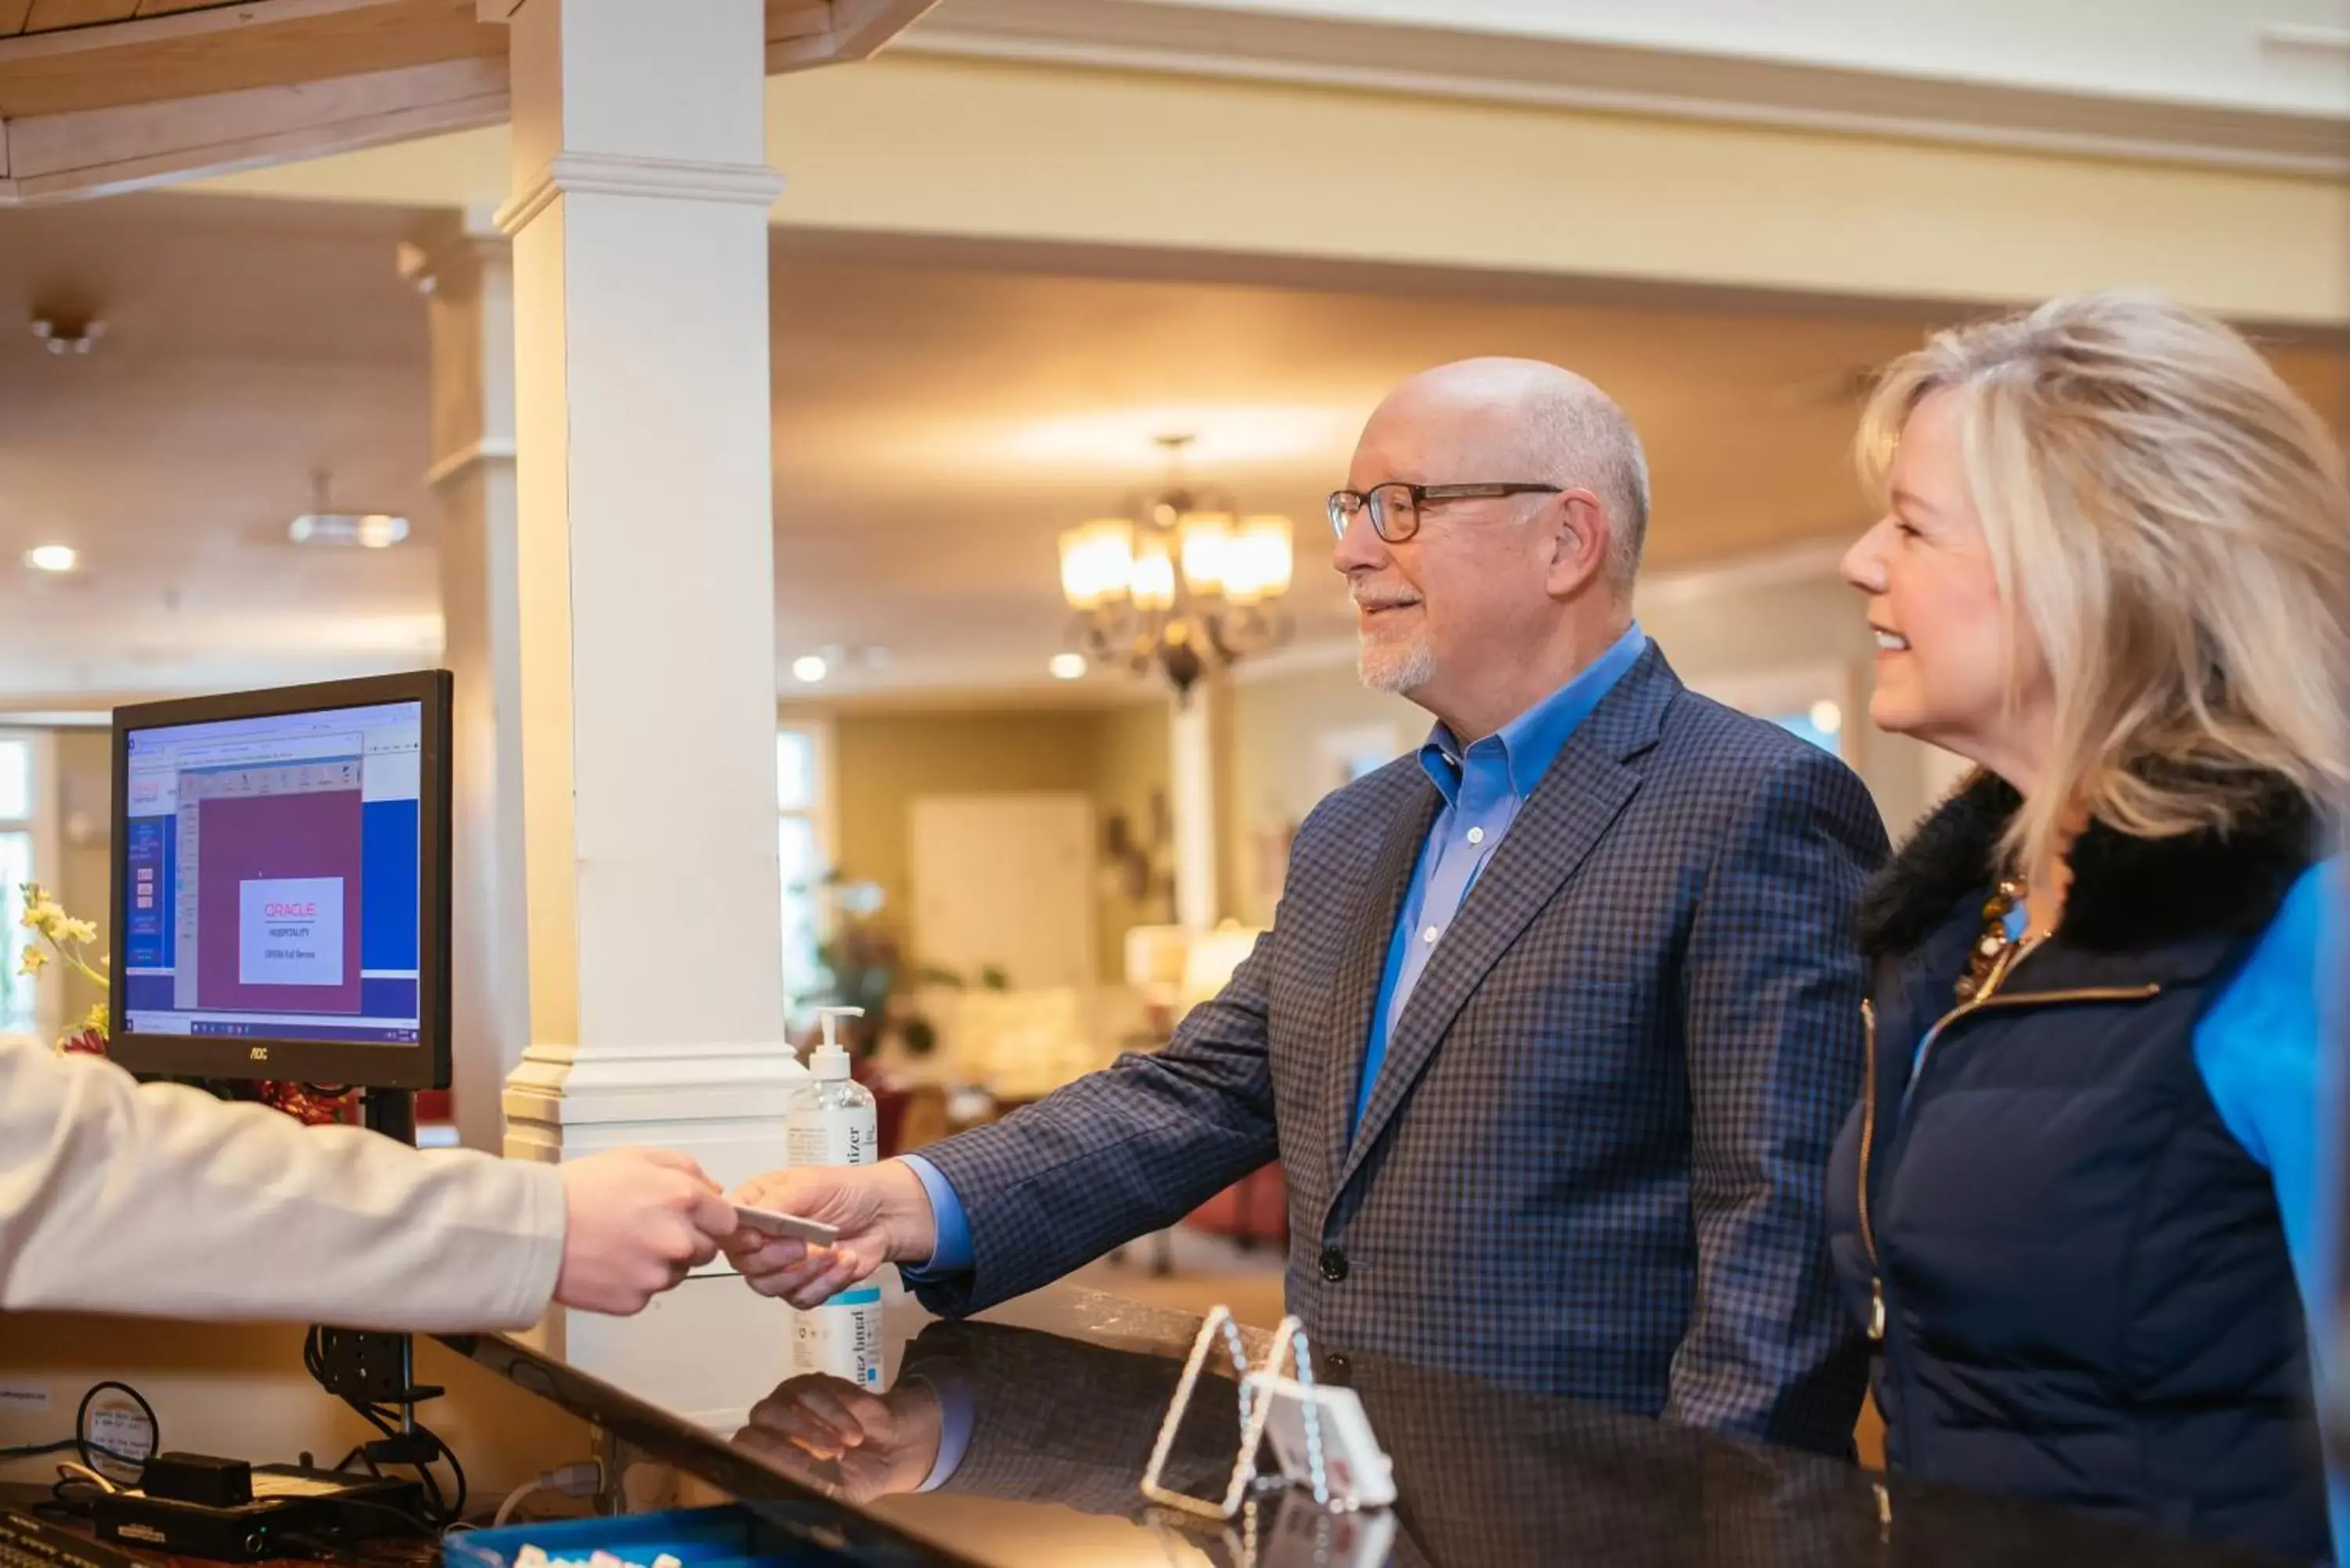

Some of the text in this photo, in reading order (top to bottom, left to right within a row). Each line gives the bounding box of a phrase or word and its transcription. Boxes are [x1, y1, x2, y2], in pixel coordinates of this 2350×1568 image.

[265, 902, 315, 917] ORACLE
[251, 1047, 267, 1060] AOC
[847, 1127, 860, 1166] tizer
